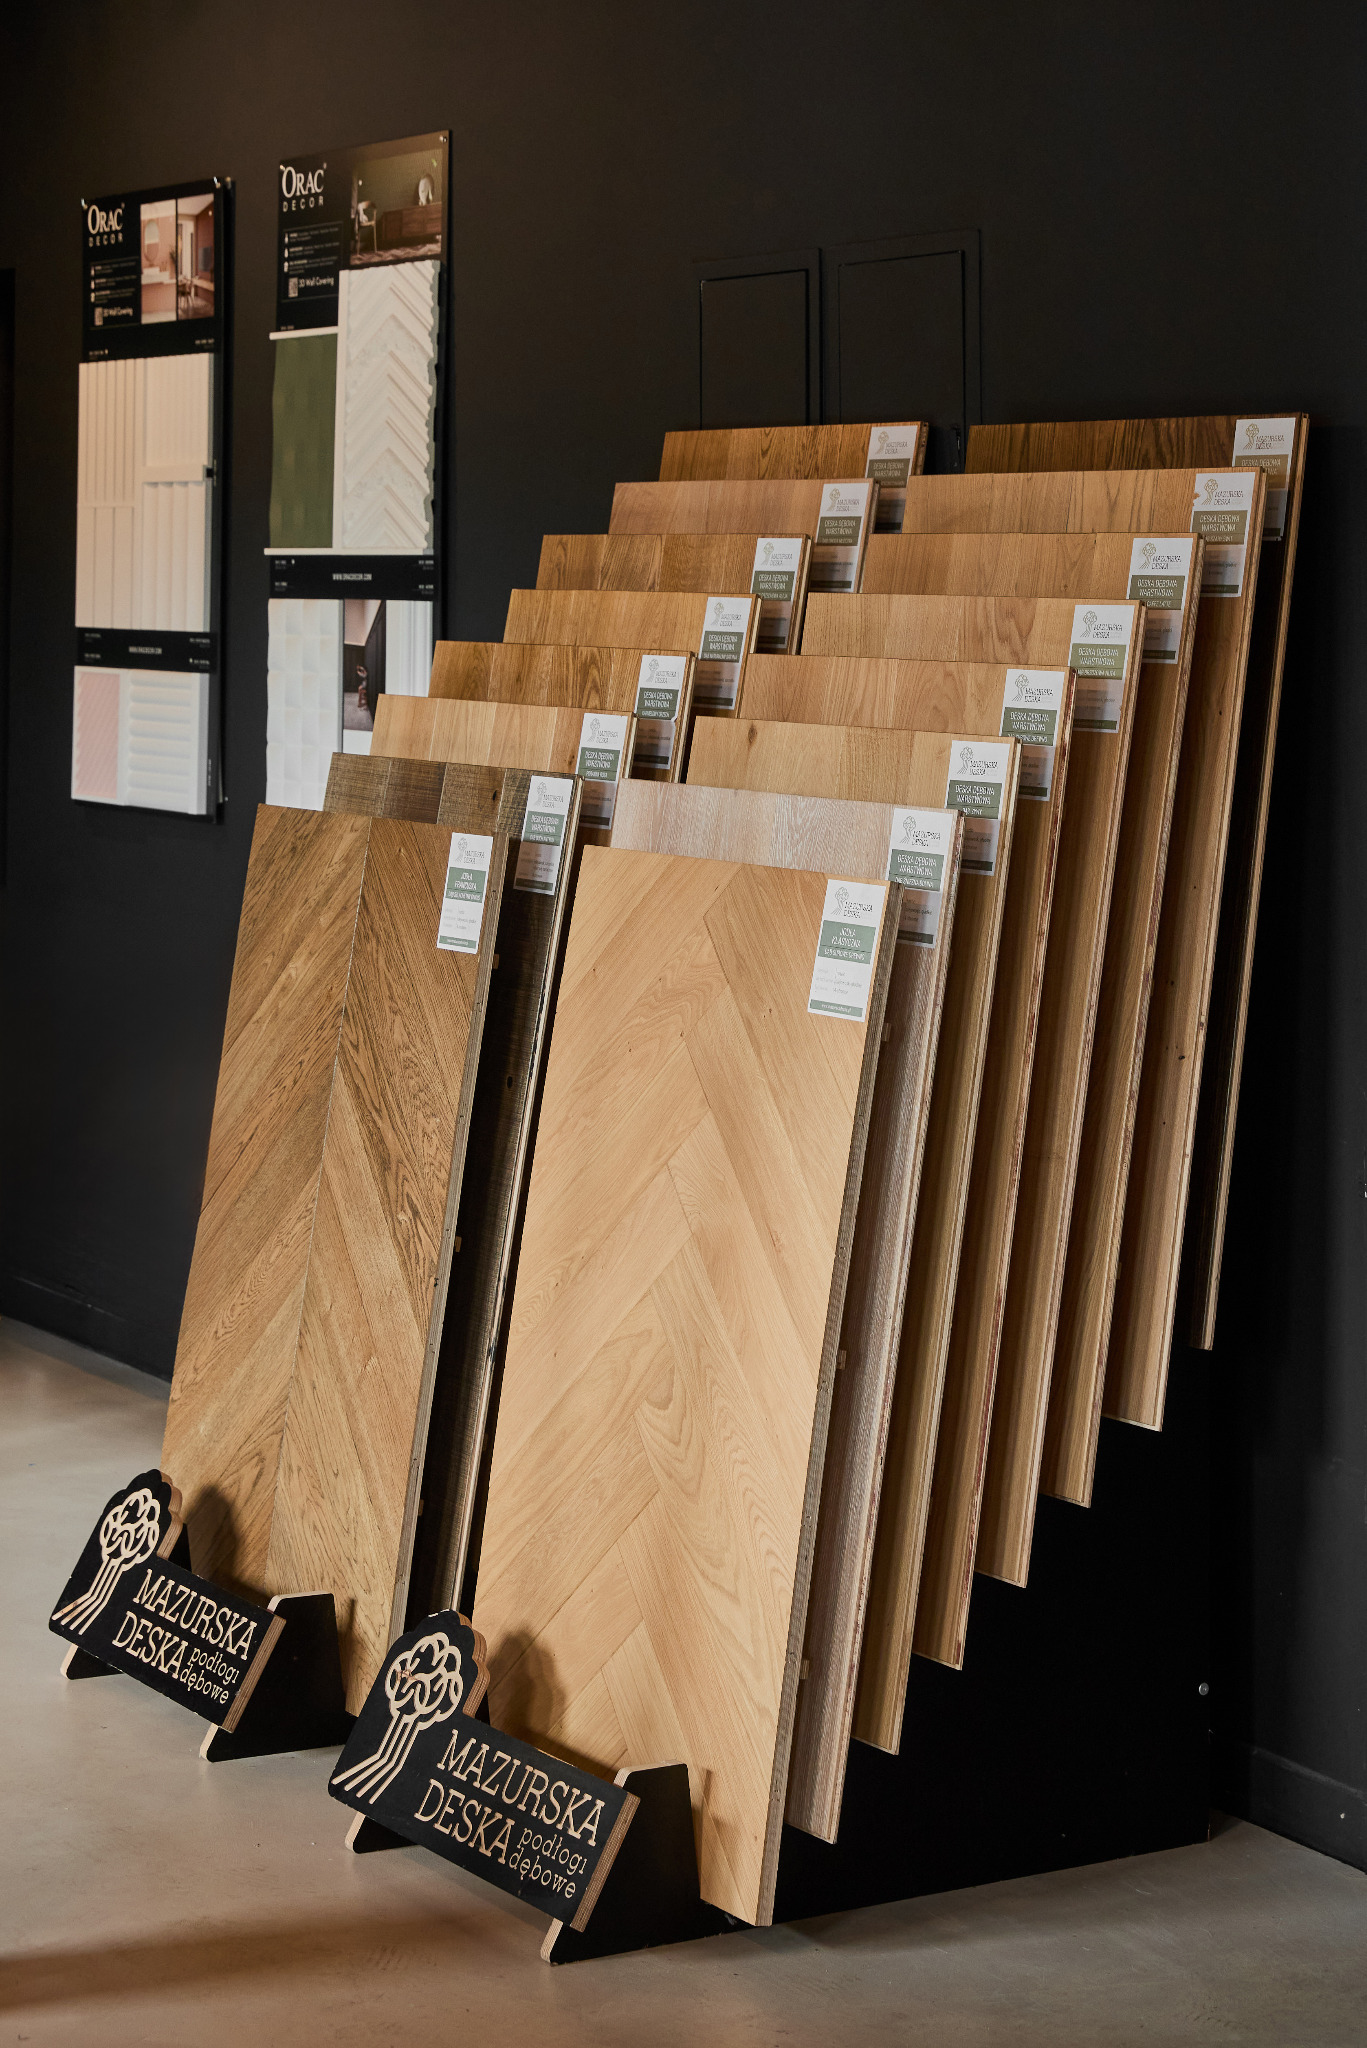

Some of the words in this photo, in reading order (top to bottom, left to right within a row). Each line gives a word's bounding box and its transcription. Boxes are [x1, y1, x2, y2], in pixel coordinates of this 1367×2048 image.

[282, 166, 324, 198] ORAC
[87, 204, 123, 234] ORAC
[282, 195, 324, 212] DECOR
[88, 232, 123, 247] DECOR
[306, 277, 316, 286] Wall
[316, 276, 334, 287] Covering
[133, 1568, 258, 1660] MAZURSKA
[112, 1611, 189, 1679] DESKA
[180, 1664, 229, 1704] dębowe
[188, 1648, 239, 1685] podłogi
[436, 1728, 606, 1847] MAZURSKA
[414, 1779, 516, 1864] DESKA
[516, 1828, 588, 1875] podłogi
[509, 1849, 577, 1900] dębowe
